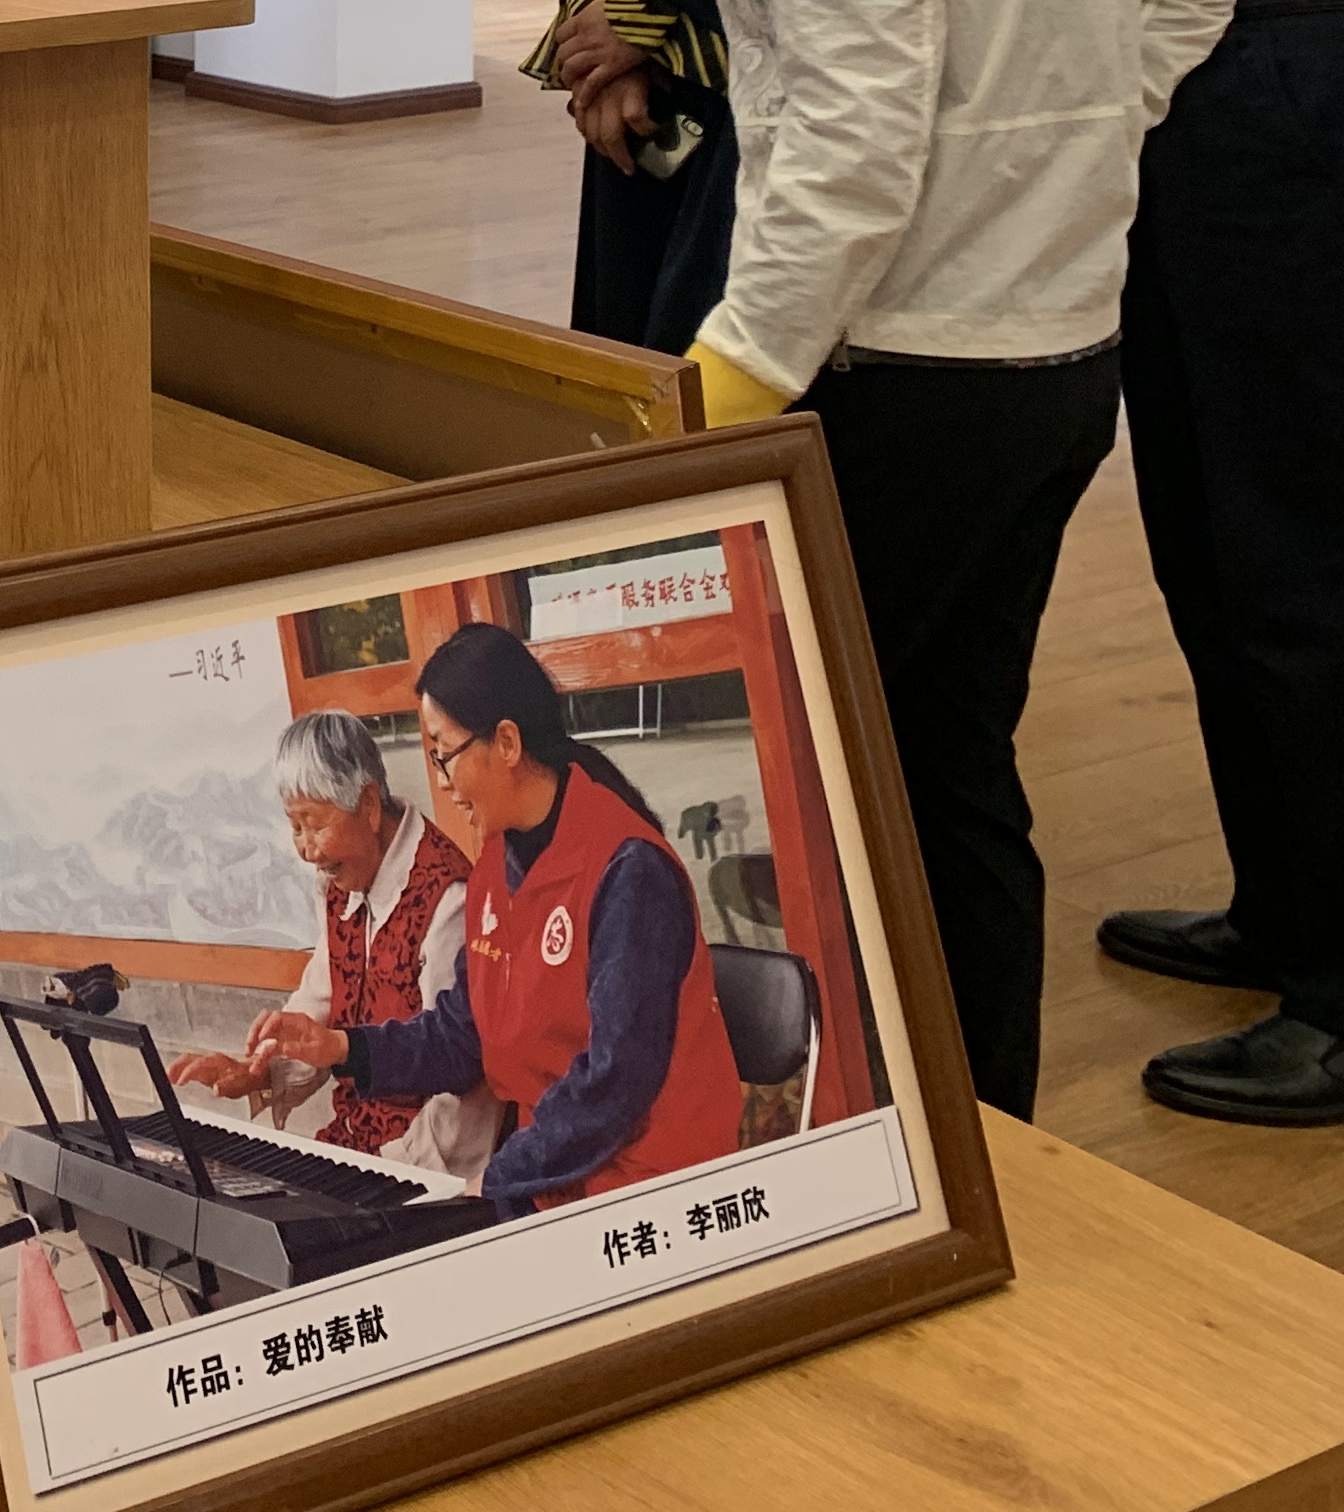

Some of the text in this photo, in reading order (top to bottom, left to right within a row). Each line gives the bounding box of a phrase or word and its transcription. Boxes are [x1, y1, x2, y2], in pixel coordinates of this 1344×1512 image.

[602, 1185, 771, 1270] 作者：李丽欣
[166, 1304, 389, 1409] 作品：爱的奉献
